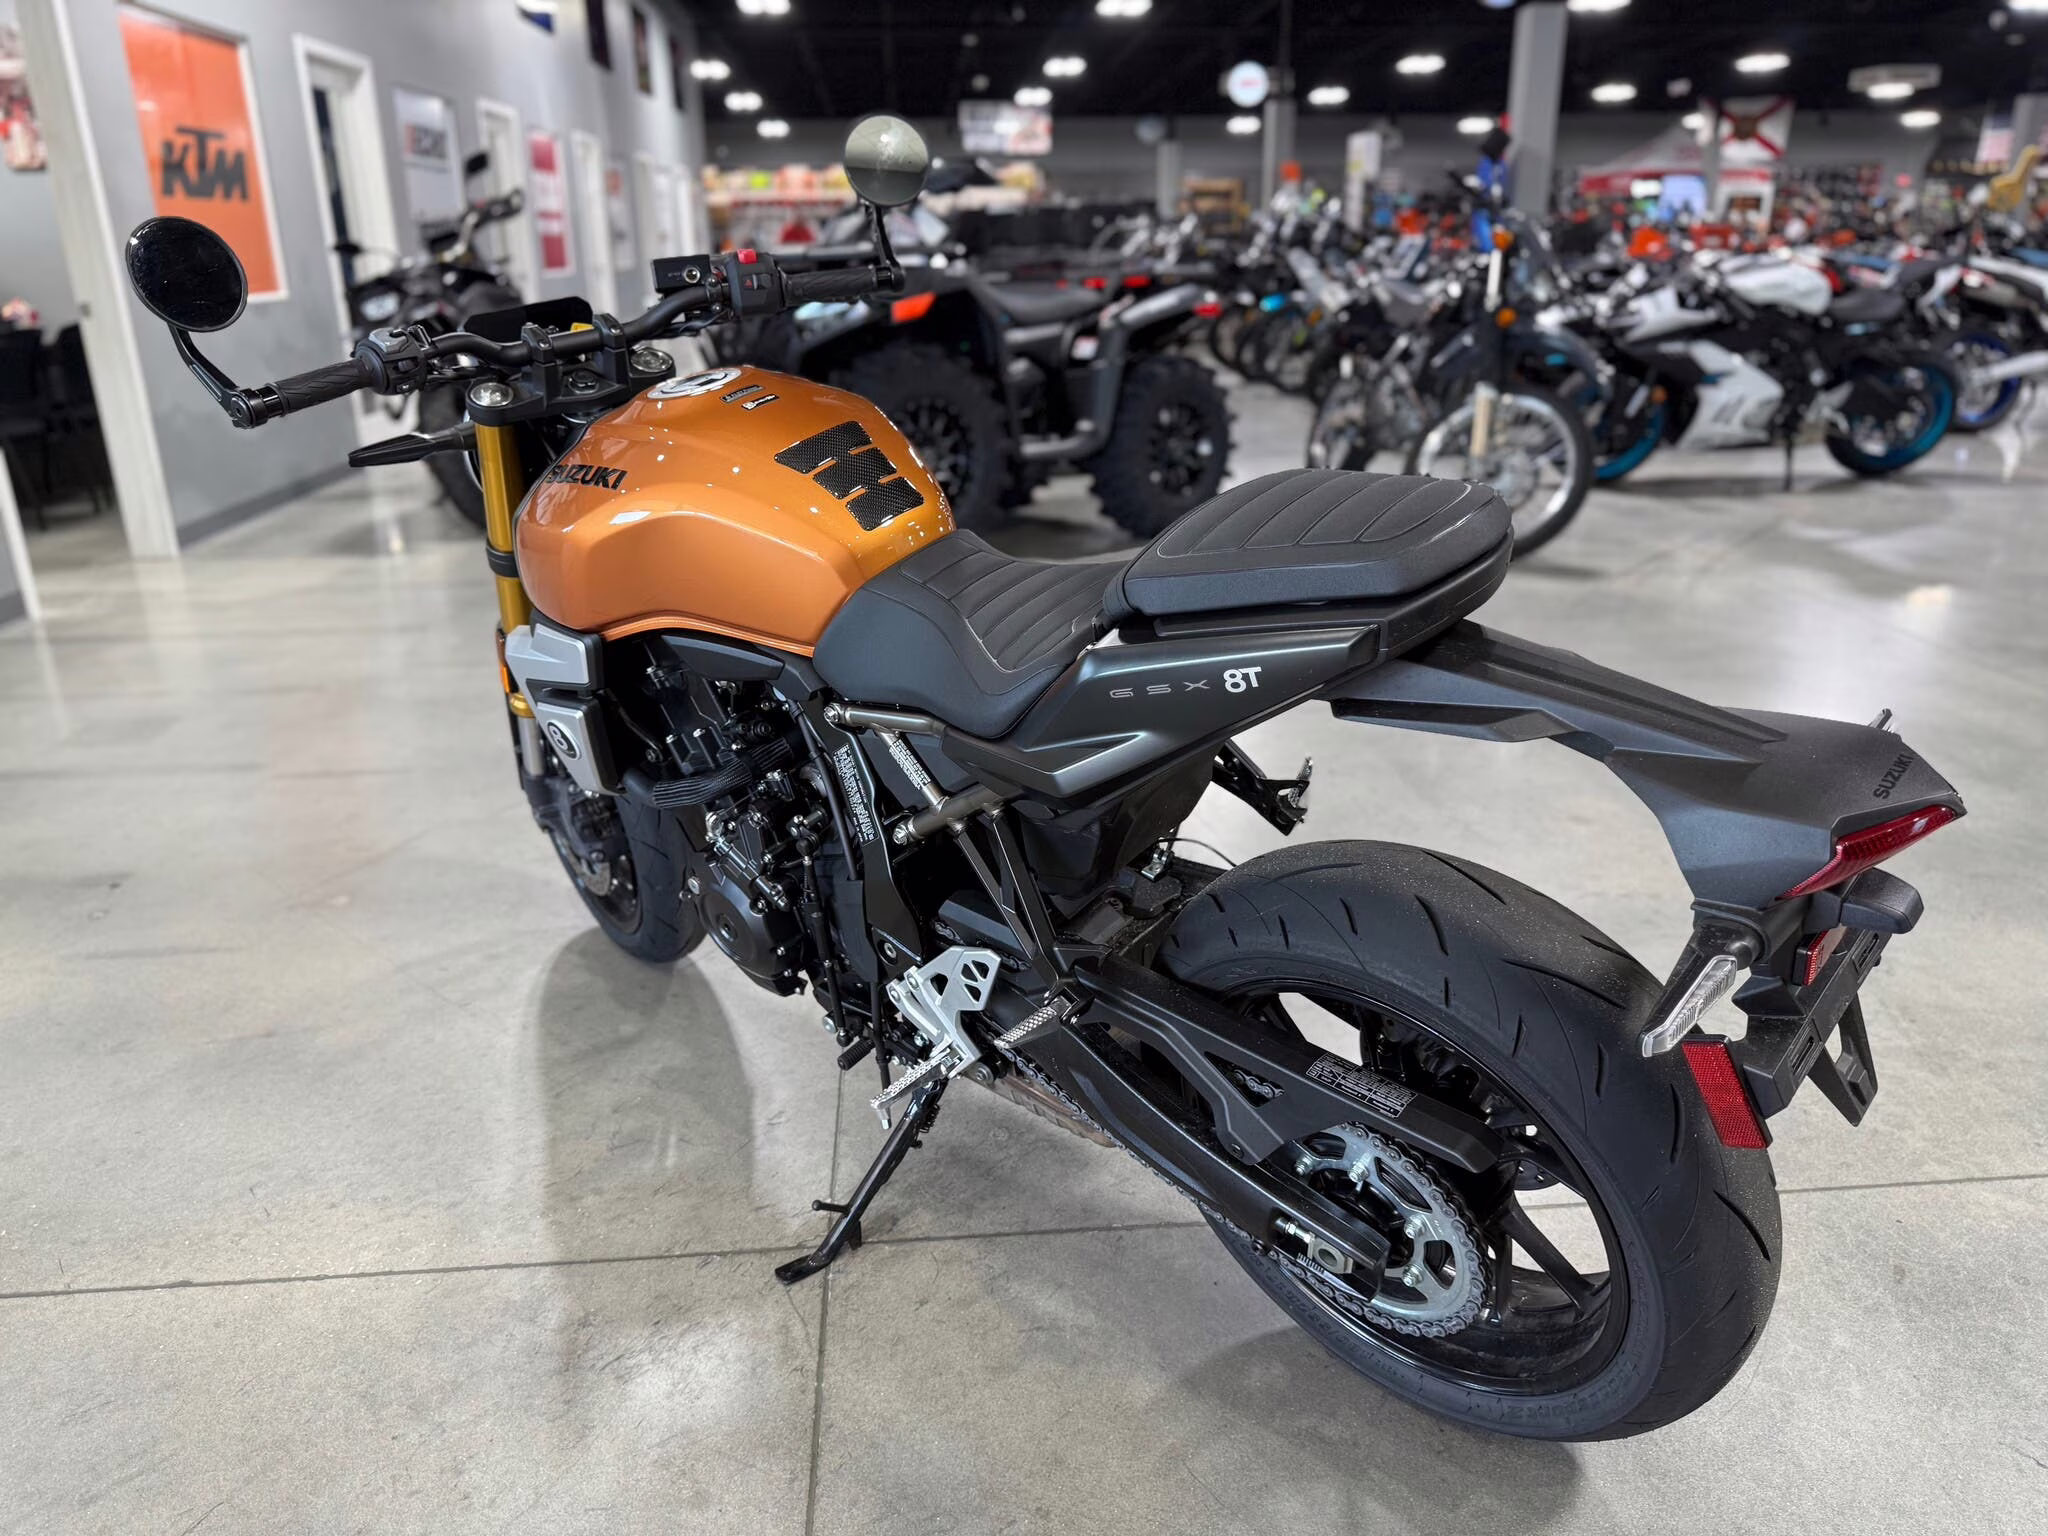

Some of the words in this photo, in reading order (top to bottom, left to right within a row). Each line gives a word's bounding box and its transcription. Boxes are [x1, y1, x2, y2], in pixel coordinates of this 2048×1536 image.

[162, 126, 248, 201] KTM
[546, 464, 627, 490] SUZUKI
[1223, 666, 1262, 693] 8T
[1873, 754, 1914, 799] SUZUKI
